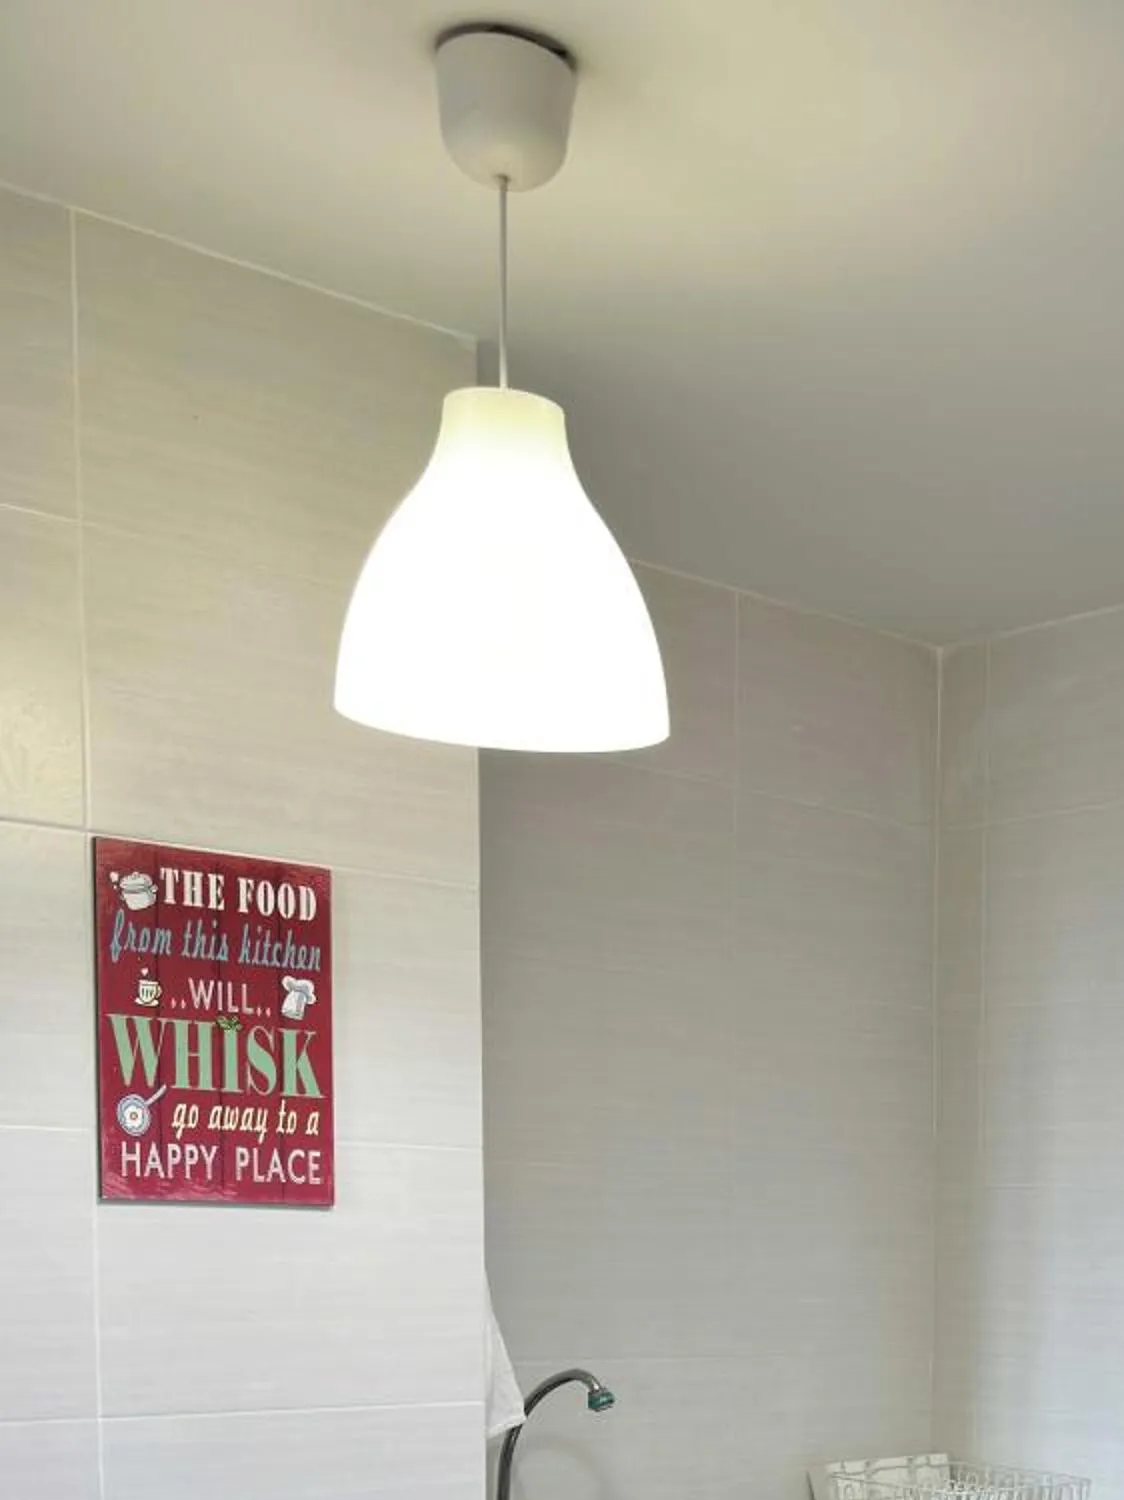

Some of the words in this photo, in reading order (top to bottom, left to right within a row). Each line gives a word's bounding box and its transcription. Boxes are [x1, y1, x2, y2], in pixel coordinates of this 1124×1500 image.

[160, 867, 225, 911] THE
[236, 877, 317, 921] FOOD
[109, 908, 172, 963] from
[182, 920, 229, 962] this
[238, 923, 322, 971] kitchen
[106, 1013, 328, 1099] WHISK
[171, 1103, 200, 1138] go
[208, 1106, 267, 1143] away
[276, 1100, 297, 1135] to
[305, 1111, 320, 1135] a
[121, 1142, 219, 1180] HAPPY
[235, 1147, 322, 1185] PLACE
